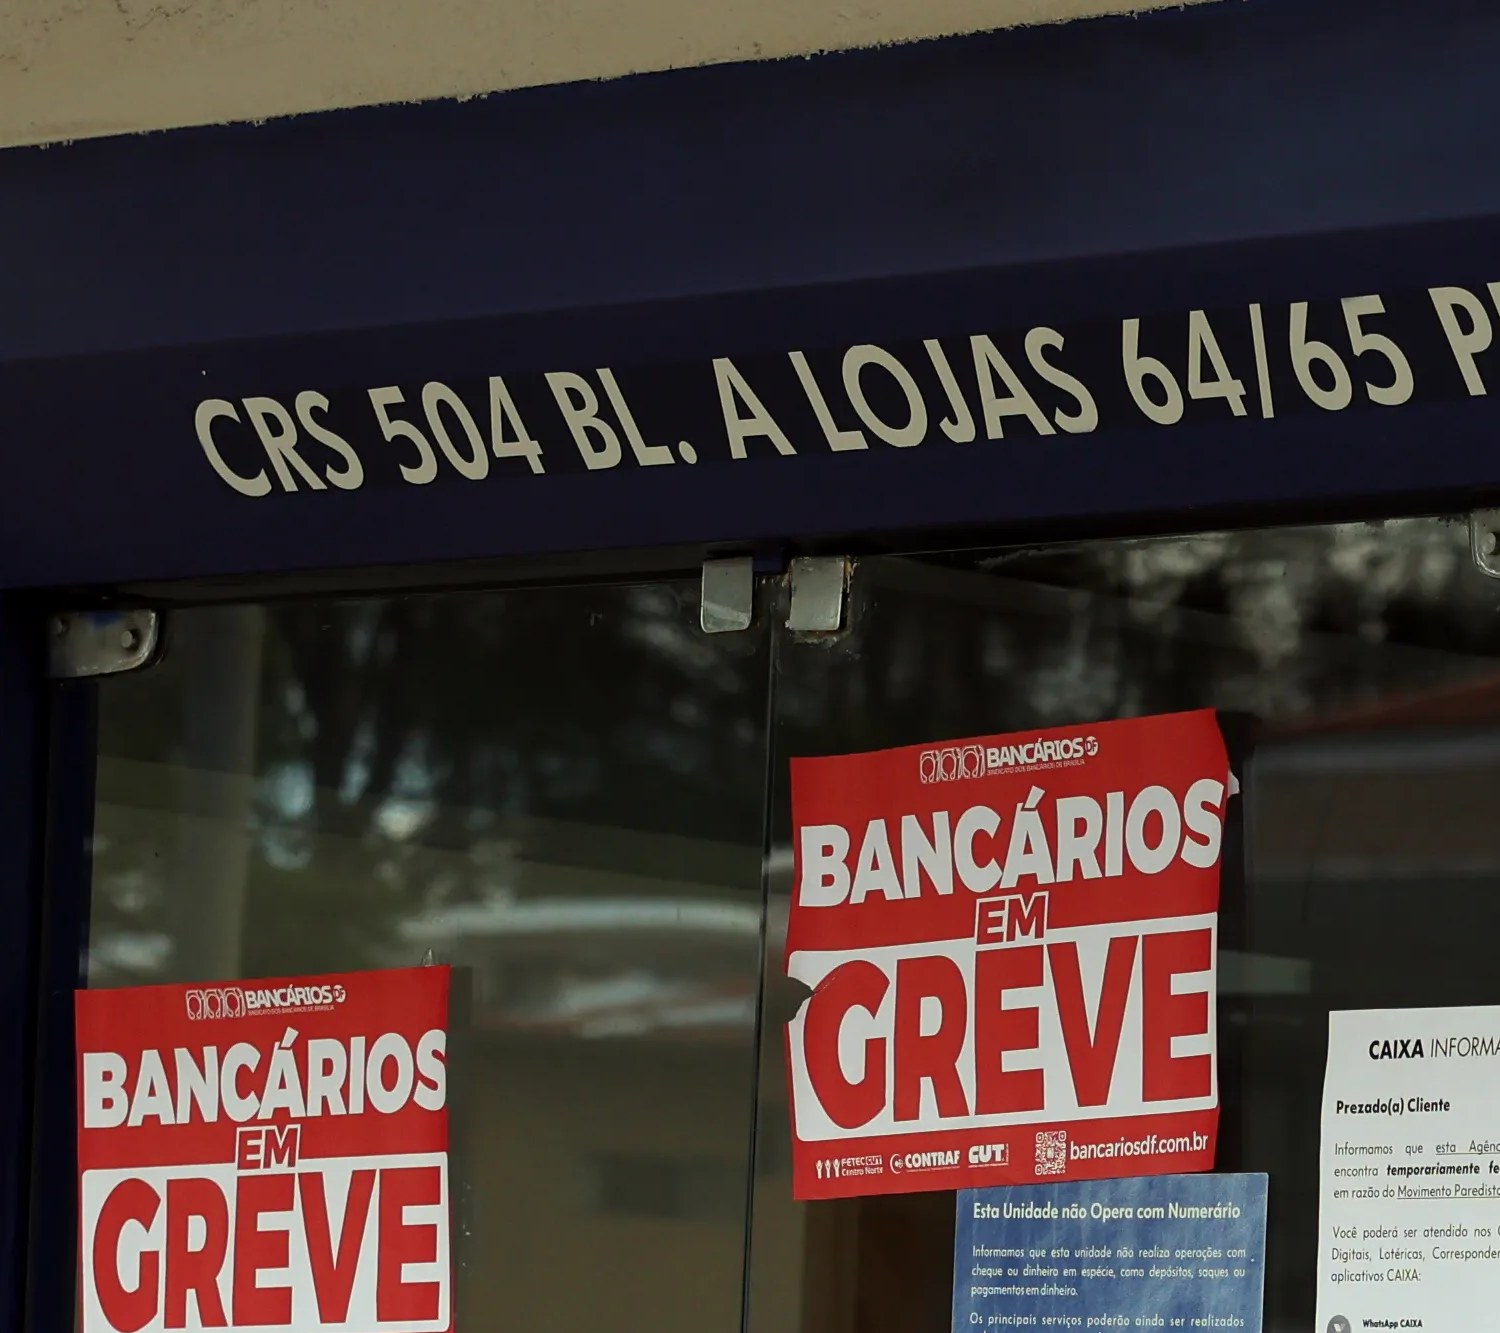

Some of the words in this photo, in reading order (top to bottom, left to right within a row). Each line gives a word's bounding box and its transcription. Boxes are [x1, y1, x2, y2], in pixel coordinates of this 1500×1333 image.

[195, 391, 363, 496] CRS
[374, 376, 545, 484] 504
[560, 368, 697, 470] BL.
[718, 351, 800, 459] A
[807, 327, 1098, 451] LOJAS
[1123, 295, 1414, 424] 64/65
[987, 738, 1083, 767] BANCÁRIOS
[800, 778, 1224, 907] BANCÁRIOS
[976, 891, 1049, 944] EM
[247, 985, 332, 1008] BANCÁRIOS
[804, 928, 1212, 1129] GREVE
[1369, 1039, 1424, 1059] CAIXA
[83, 1027, 446, 1128] BANCÁRIOS
[1337, 1098, 1404, 1115] Prezado(a)
[1408, 1098, 1450, 1112] Cliente
[236, 1124, 300, 1169] EM
[969, 1144, 1003, 1164] CUT
[1071, 1132, 1208, 1160] bancariosdf.com.br
[905, 1152, 960, 1169] CONTRAF
[1335, 1167, 1378, 1176] encontra
[1387, 1163, 1479, 1178] temporariamente
[1334, 1190, 1348, 1198] em
[1352, 1187, 1379, 1198] razão
[1383, 1185, 1394, 1197] do
[1397, 1185, 1451, 1198] Movimento
[974, 1203, 999, 1218] Esta
[1004, 1202, 1058, 1218] Unidade
[1062, 1204, 1087, 1219] não
[1091, 1203, 1133, 1223] Opera
[1137, 1208, 1164, 1218] com
[1169, 1202, 1240, 1218] Numerário
[93, 1166, 441, 1333] GREVE
